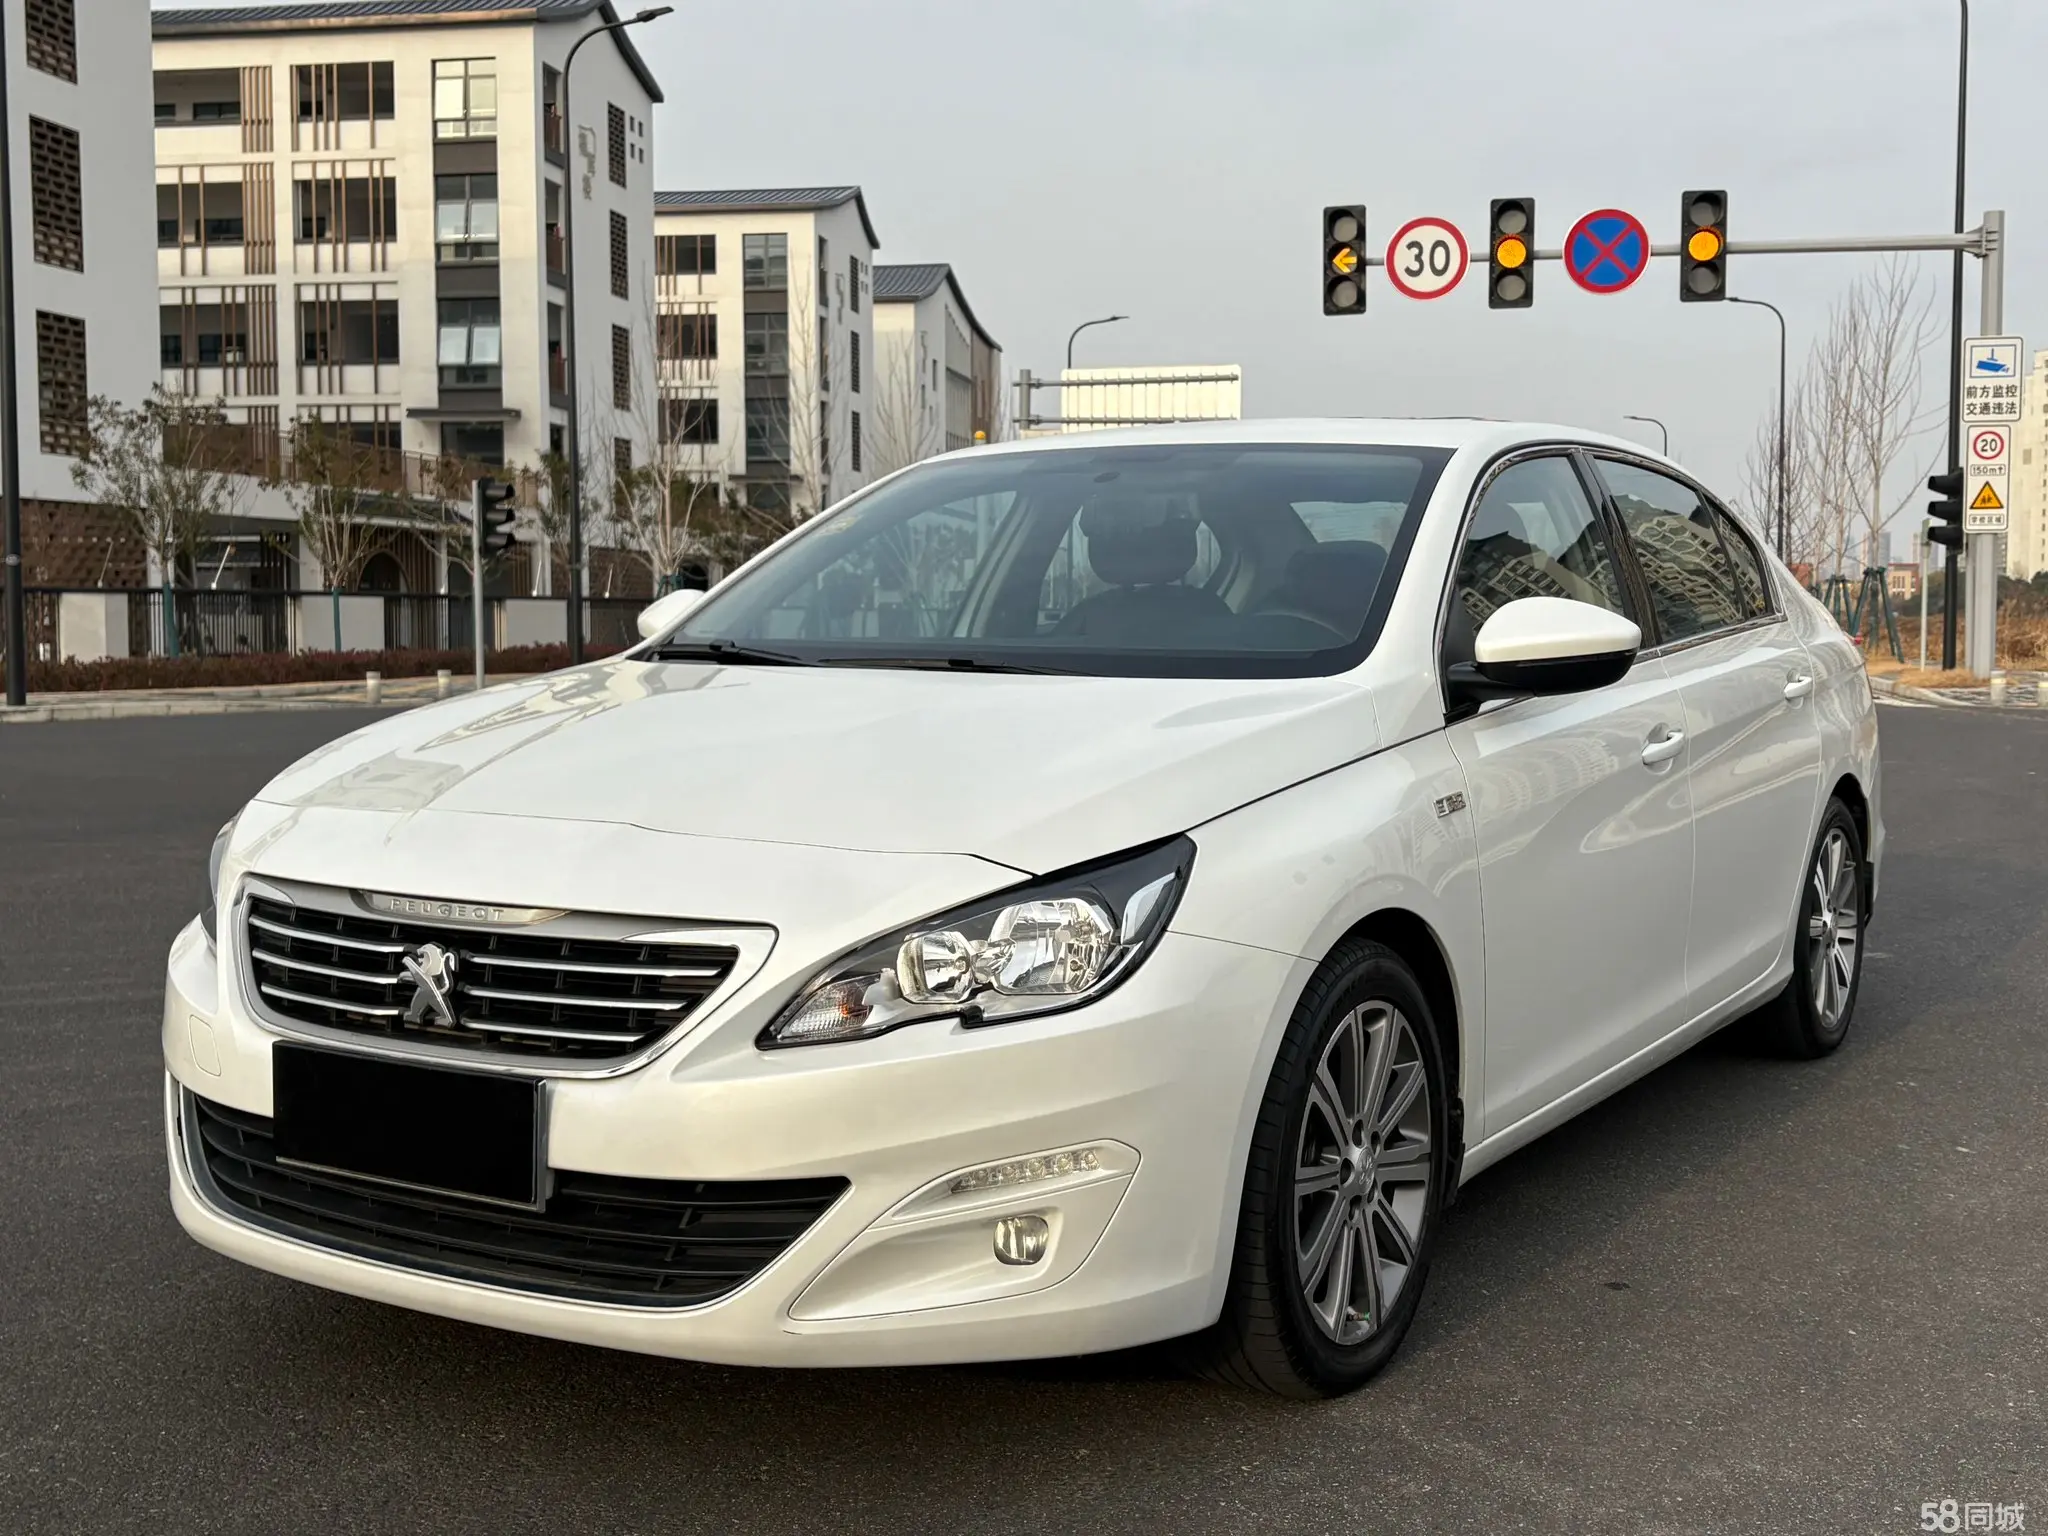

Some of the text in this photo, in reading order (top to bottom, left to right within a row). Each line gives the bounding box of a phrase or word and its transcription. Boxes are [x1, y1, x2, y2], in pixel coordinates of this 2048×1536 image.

[1404, 239, 1451, 278] 30
[1966, 384, 2018, 399] 前方监控
[1966, 401, 2017, 416] 交通违法
[1980, 438, 1998, 452] 20
[391, 898, 504, 921] PEUGEOT
